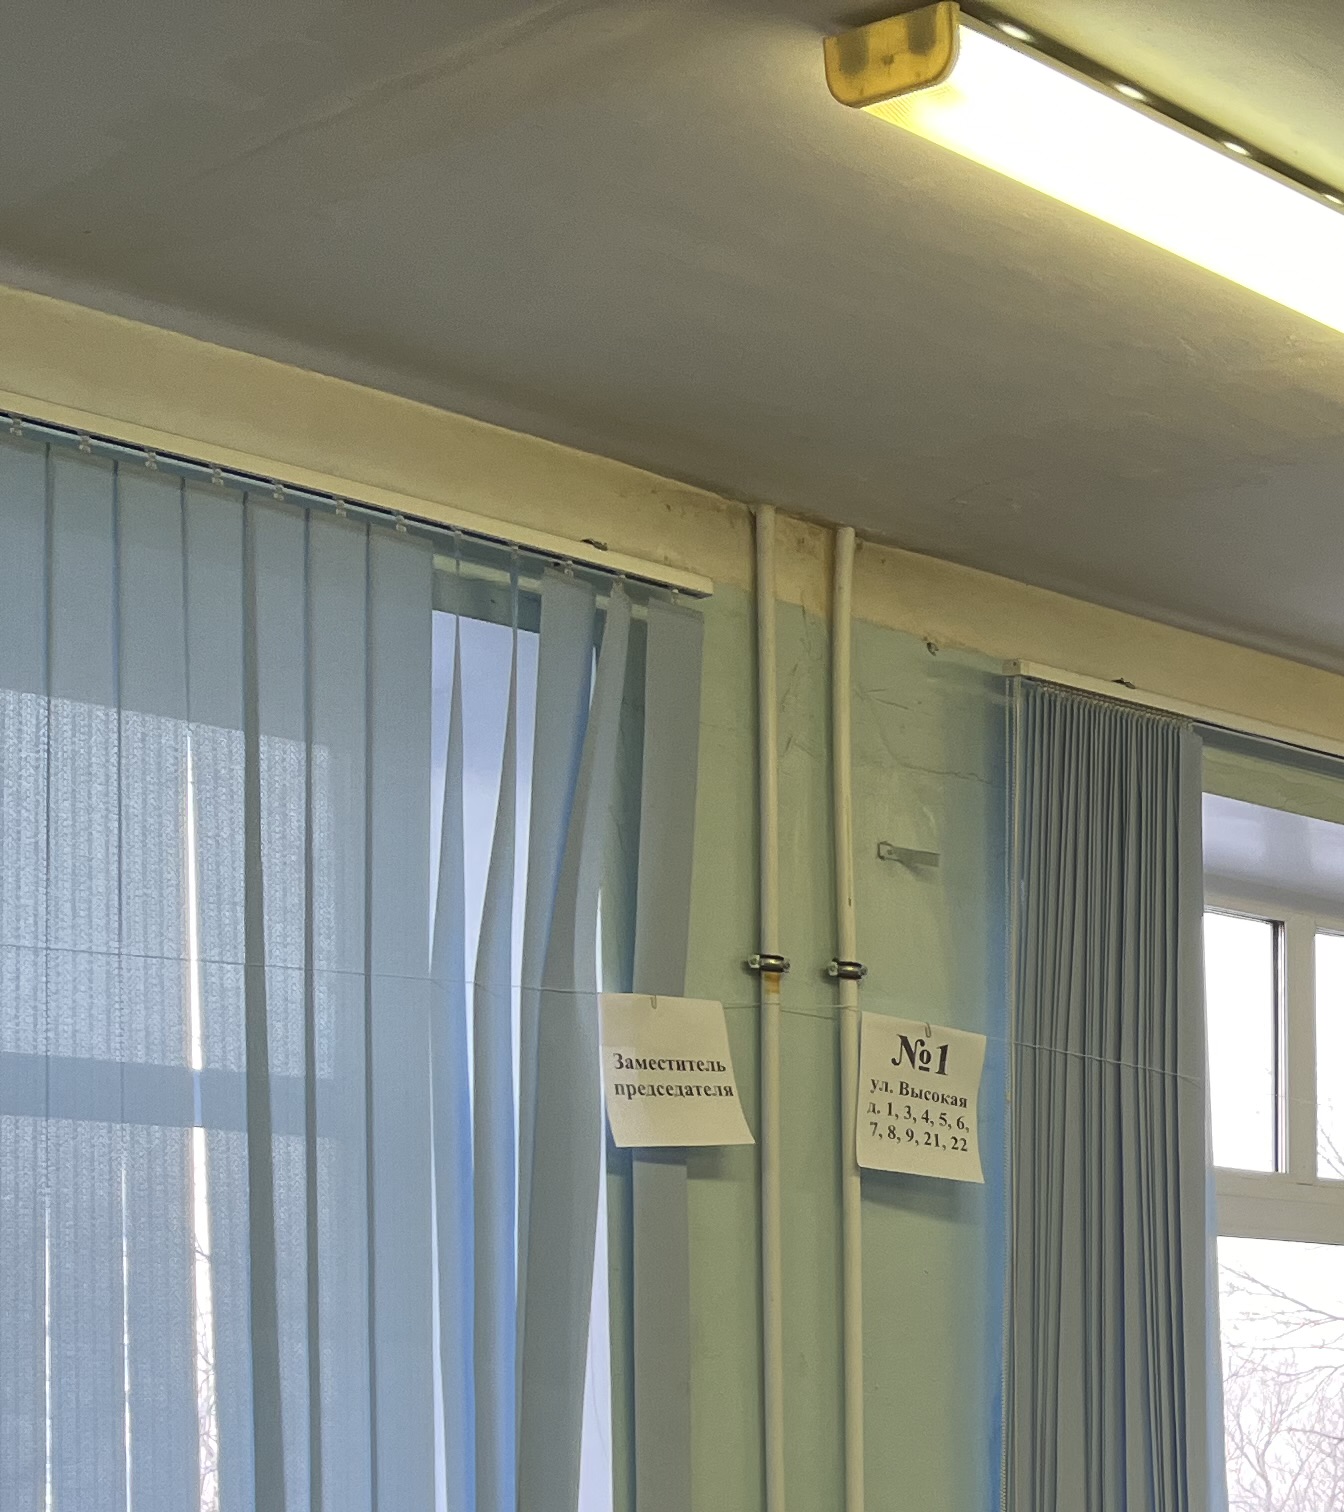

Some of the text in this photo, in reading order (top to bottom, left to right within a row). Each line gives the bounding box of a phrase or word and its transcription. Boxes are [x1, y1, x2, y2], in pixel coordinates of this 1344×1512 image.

[613, 1052, 727, 1073] Заместитель
[891, 1033, 949, 1076] №1
[614, 1083, 734, 1101] председателя
[870, 1078, 968, 1109] ул. Высокая
[866, 1102, 970, 1134] д. 1, 3, 4, 5, 6,
[869, 1121, 969, 1153] 7, 8, 9, 21, 22
